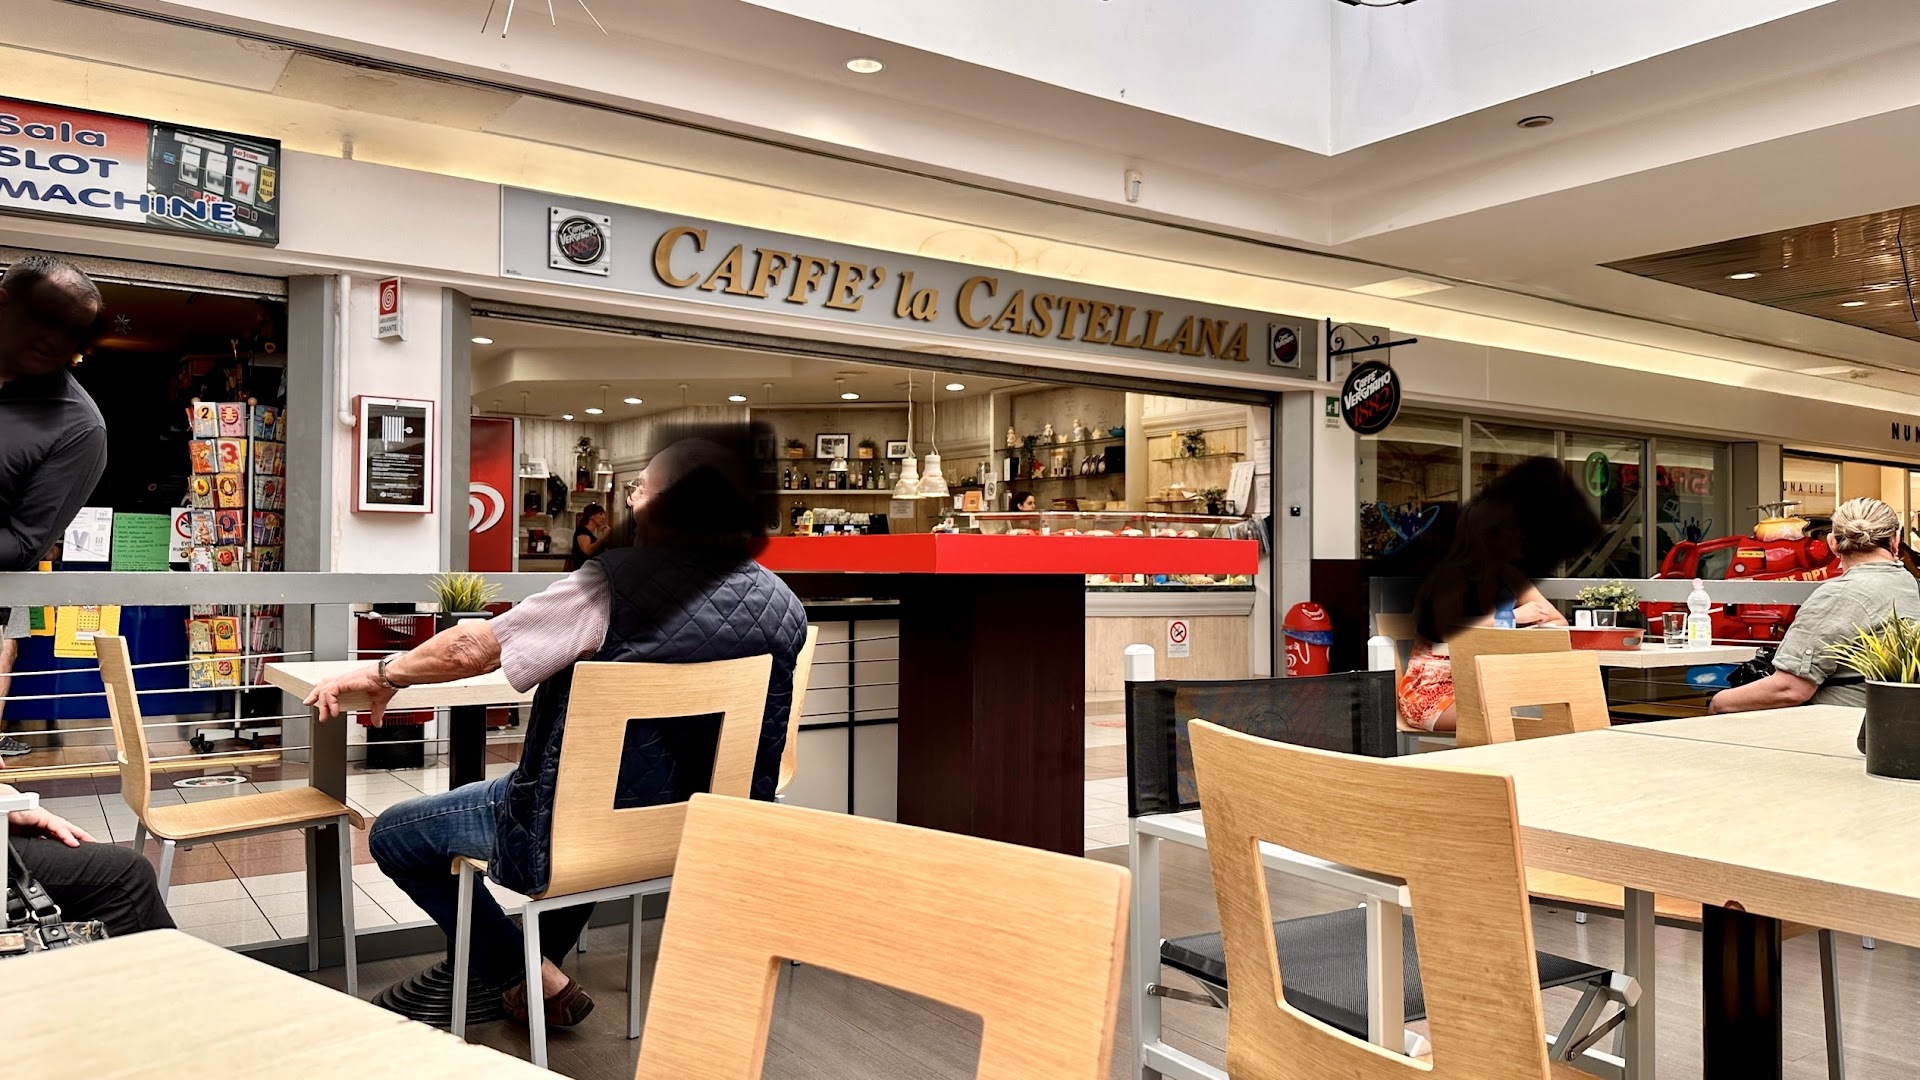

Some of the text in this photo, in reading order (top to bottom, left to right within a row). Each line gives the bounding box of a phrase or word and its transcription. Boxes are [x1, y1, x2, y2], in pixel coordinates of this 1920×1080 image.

[0, 113, 105, 147] Sala
[0, 145, 119, 178] SLOT
[0, 177, 235, 222] MACHINE
[560, 226, 597, 246] VERGNANO
[896, 271, 939, 321] la
[956, 276, 1249, 361] CASTELLANA
[1343, 370, 1391, 411] VERGNANO
[1353, 386, 1390, 426] 1882
[220, 442, 238, 464] 3
[1809, 483, 1824, 494] LIE
